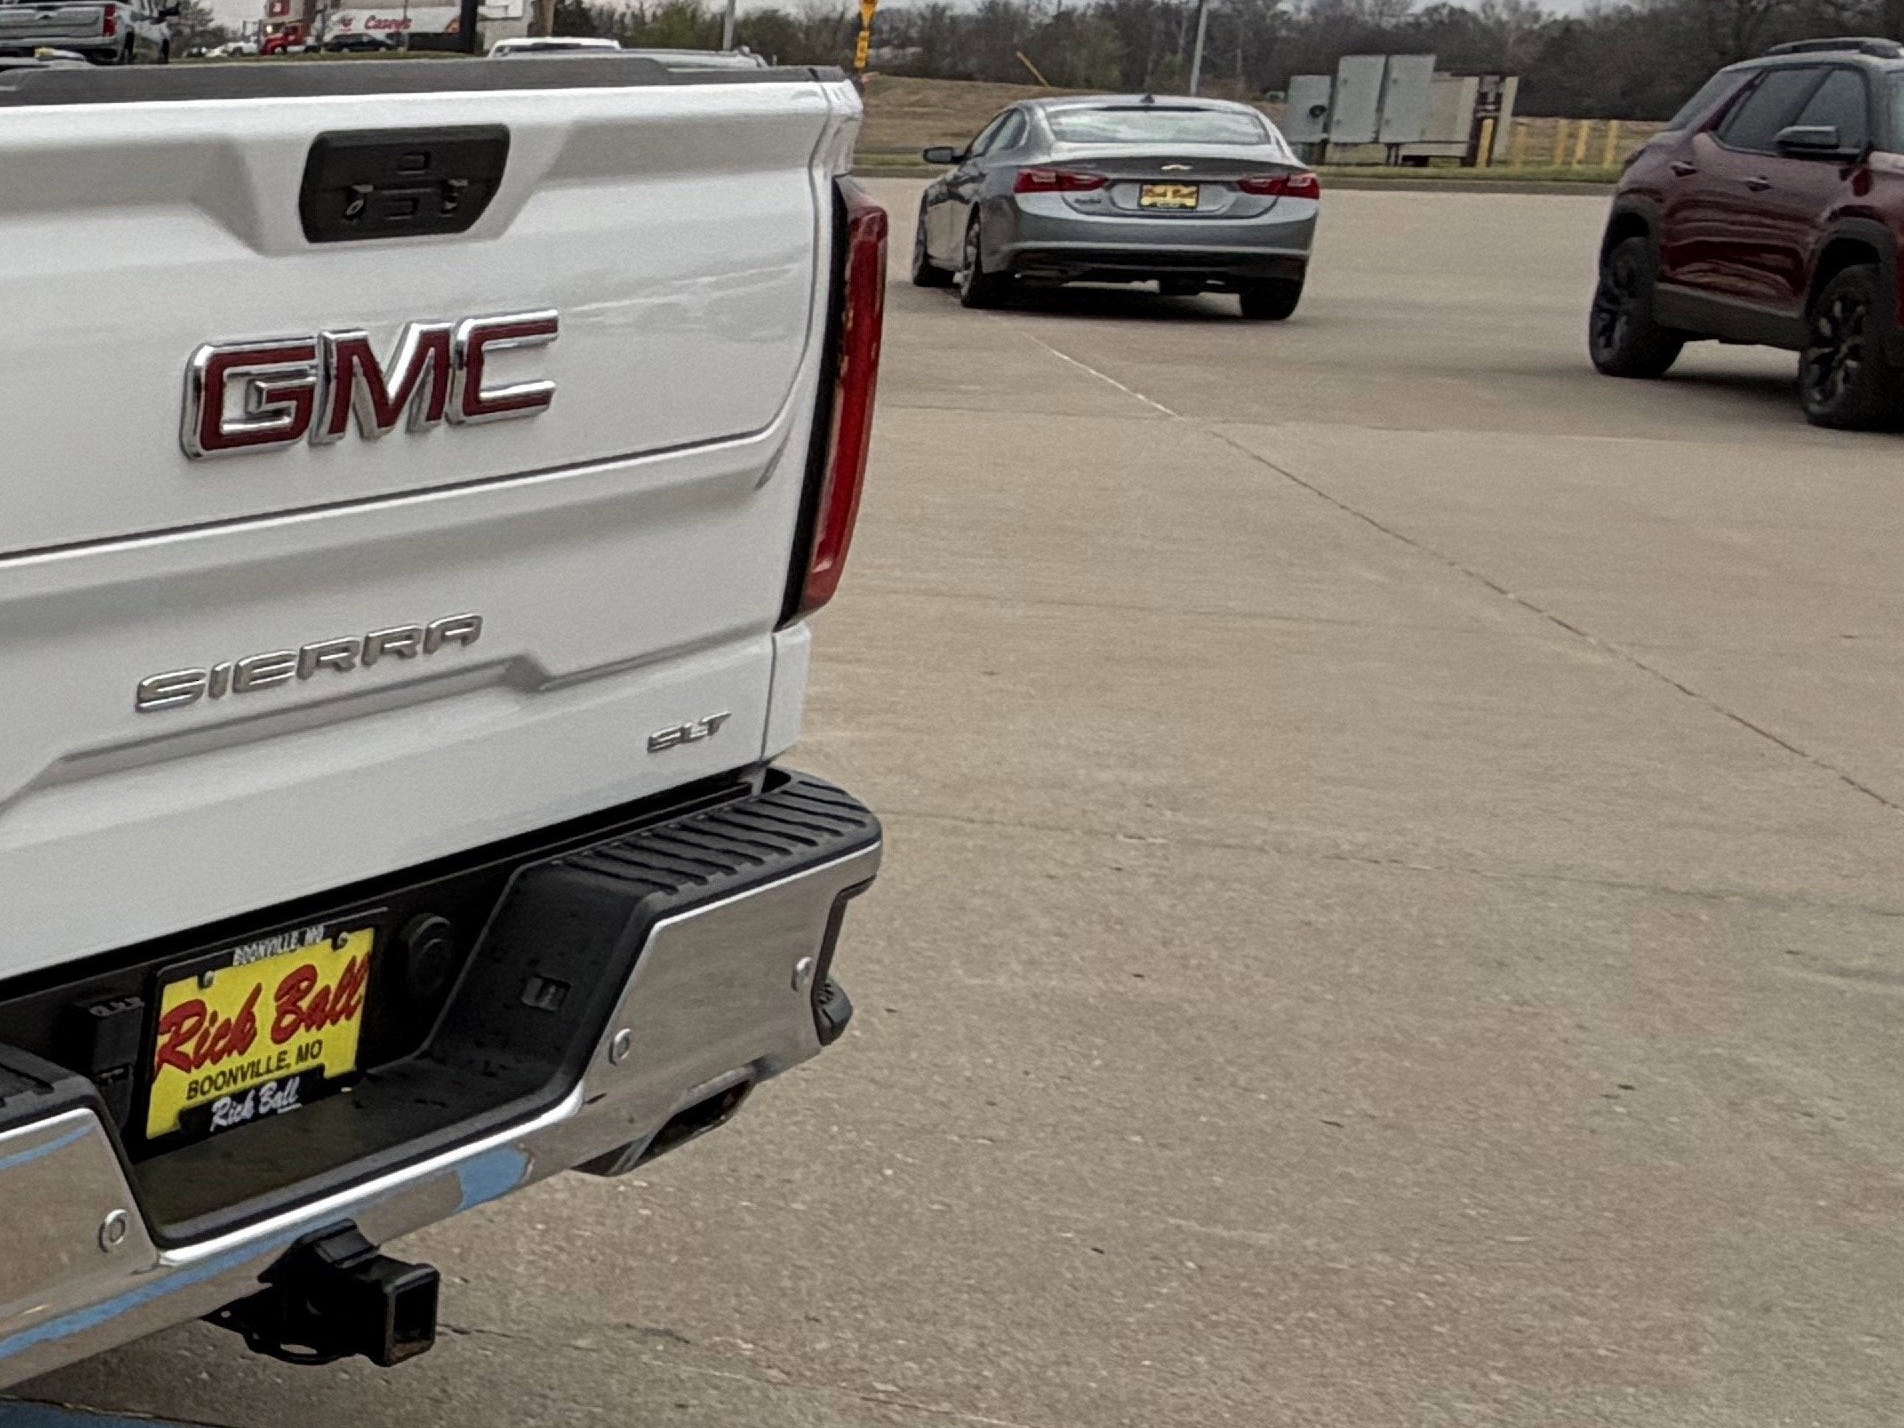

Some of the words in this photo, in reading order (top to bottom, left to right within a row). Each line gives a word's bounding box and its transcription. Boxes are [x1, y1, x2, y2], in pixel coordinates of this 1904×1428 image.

[180, 309, 559, 458] GMC
[135, 613, 483, 713] SIERRA
[647, 711, 732, 753] SLT
[153, 983, 263, 1085] Rick
[270, 950, 372, 1045] Ball
[186, 1049, 291, 1101] BOONVILLE,
[295, 1040, 324, 1066] MO
[210, 1089, 256, 1133] Rick
[258, 1076, 302, 1115] Ball
